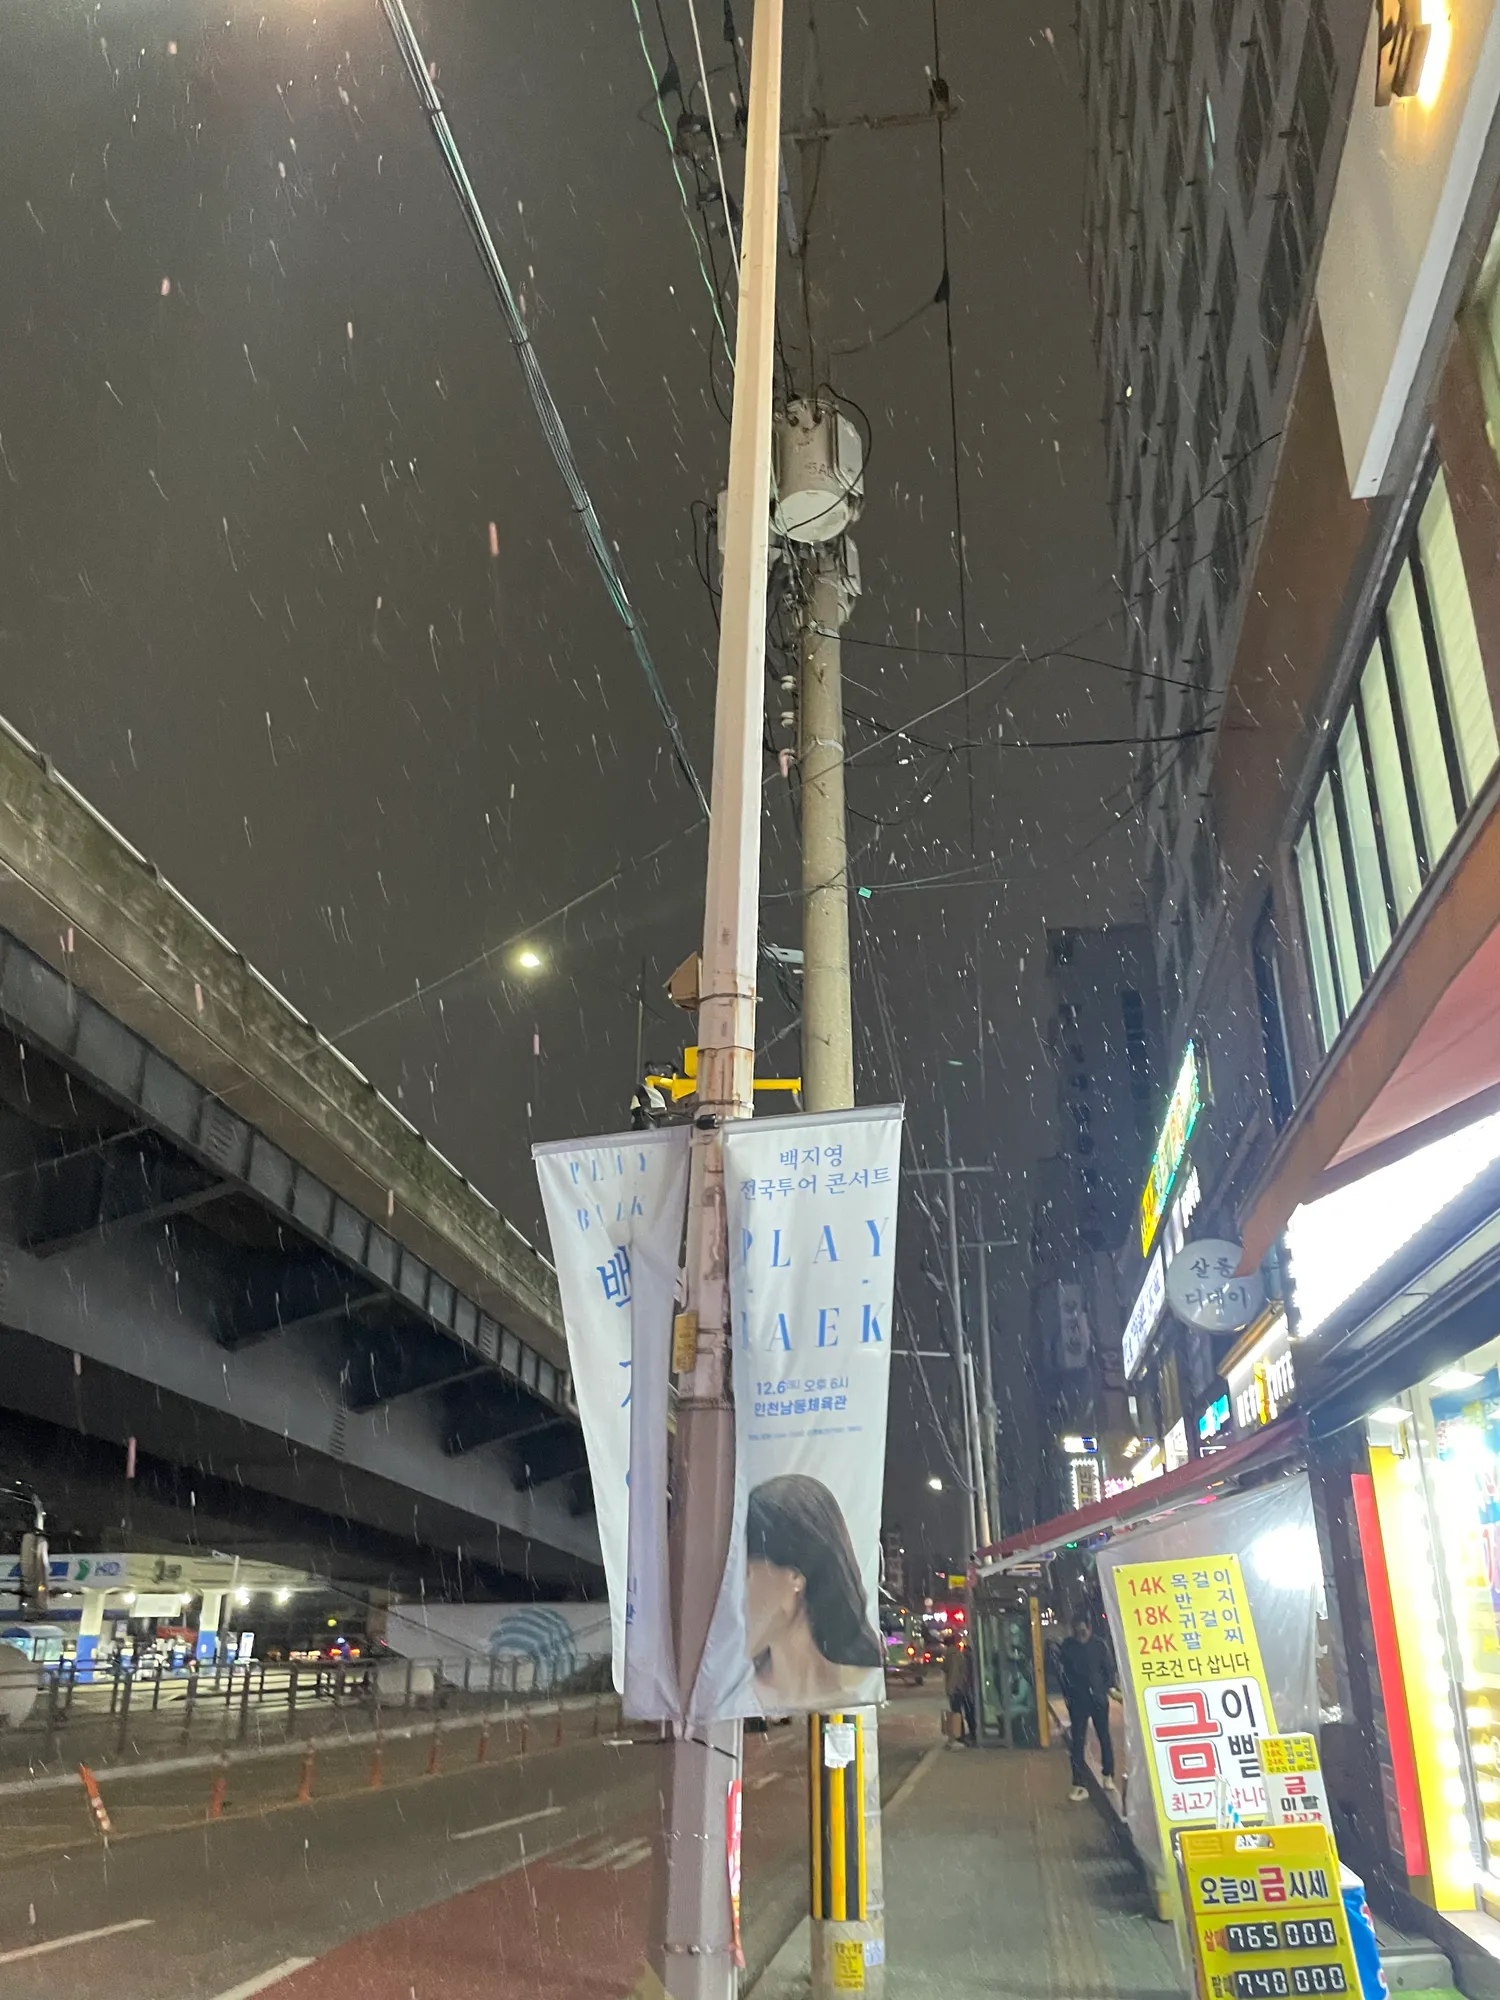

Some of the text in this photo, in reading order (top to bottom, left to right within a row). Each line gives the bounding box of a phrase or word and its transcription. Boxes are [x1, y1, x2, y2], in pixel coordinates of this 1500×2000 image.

[779, 1144, 843, 1171] 백지영
[740, 1167, 892, 1201] 전국투어 콘서트
[741, 1217, 890, 1268] PLAY
[830, 1376, 849, 1390] 6시
[1128, 1576, 1166, 1597] 14K
[1171, 1569, 1232, 1590] 목걸이
[1134, 1604, 1173, 1627] 18K
[1179, 1607, 1241, 1629] 귀걸이
[1138, 1633, 1178, 1655] 24K
[1141, 1651, 1251, 1681] 무조건 다 삽니다
[1284, 1775, 1307, 1796] 금
[1200, 1876, 1258, 1905] 오늘의
